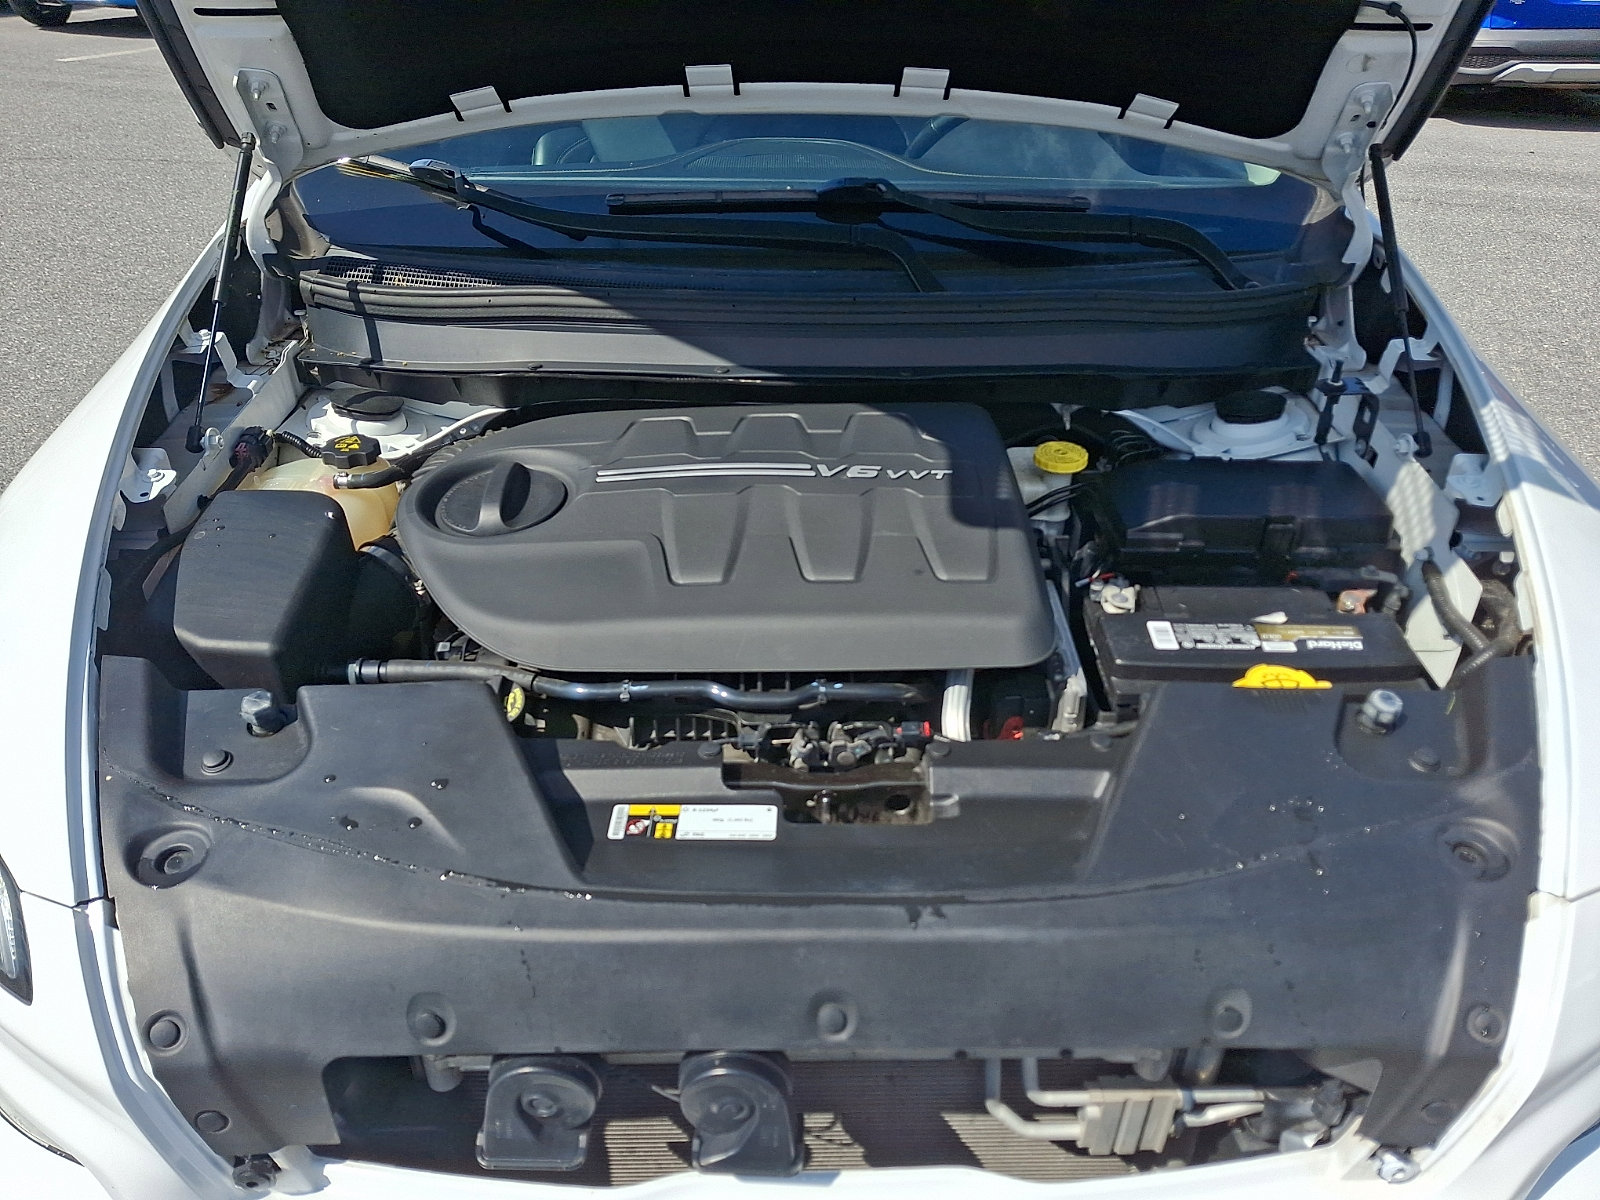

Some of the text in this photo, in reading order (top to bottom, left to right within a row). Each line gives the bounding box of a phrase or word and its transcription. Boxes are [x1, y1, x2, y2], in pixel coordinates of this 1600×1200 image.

[817, 464, 953, 480] V6 VVT
[1306, 640, 1363, 650] DieHard
